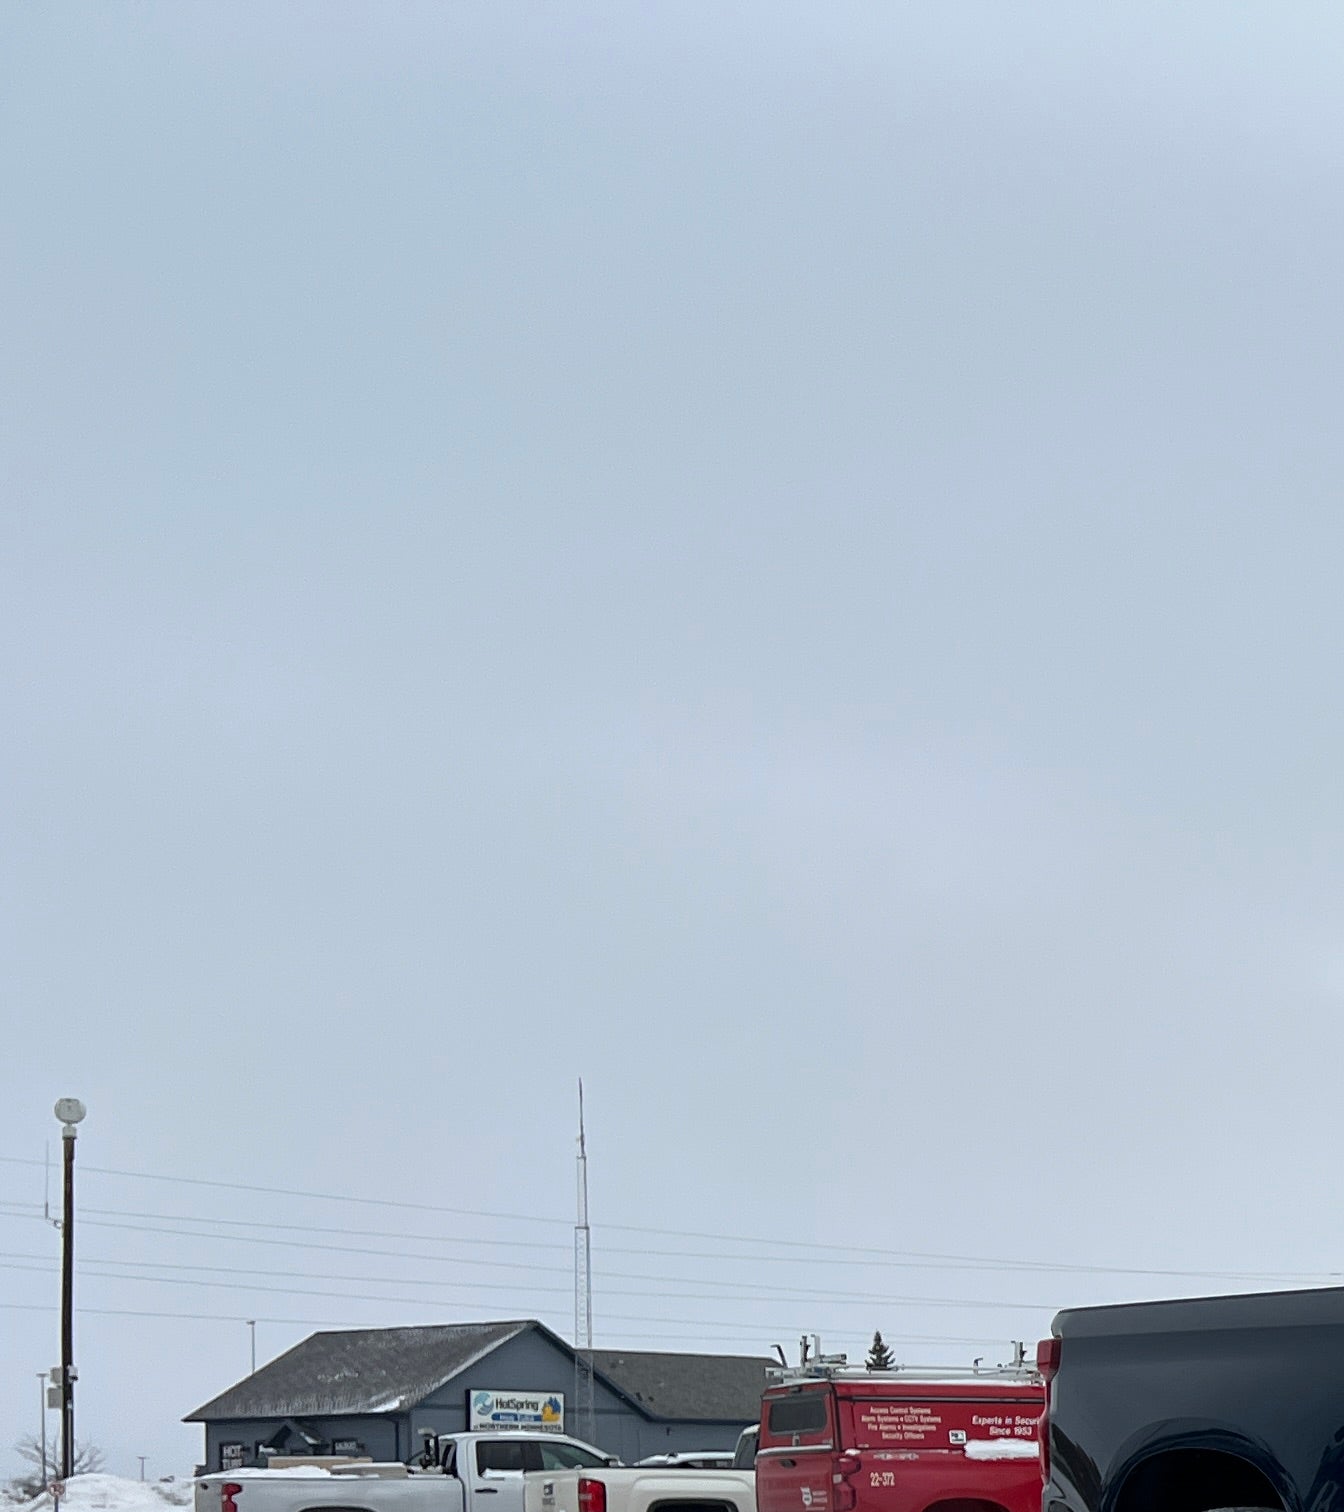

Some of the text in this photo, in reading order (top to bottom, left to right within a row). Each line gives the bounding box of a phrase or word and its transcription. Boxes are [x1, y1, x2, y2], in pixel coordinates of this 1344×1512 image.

[972, 1415, 1002, 1426] Experts
[1005, 1416, 1013, 1425] in
[989, 1426, 1011, 1435] Since
